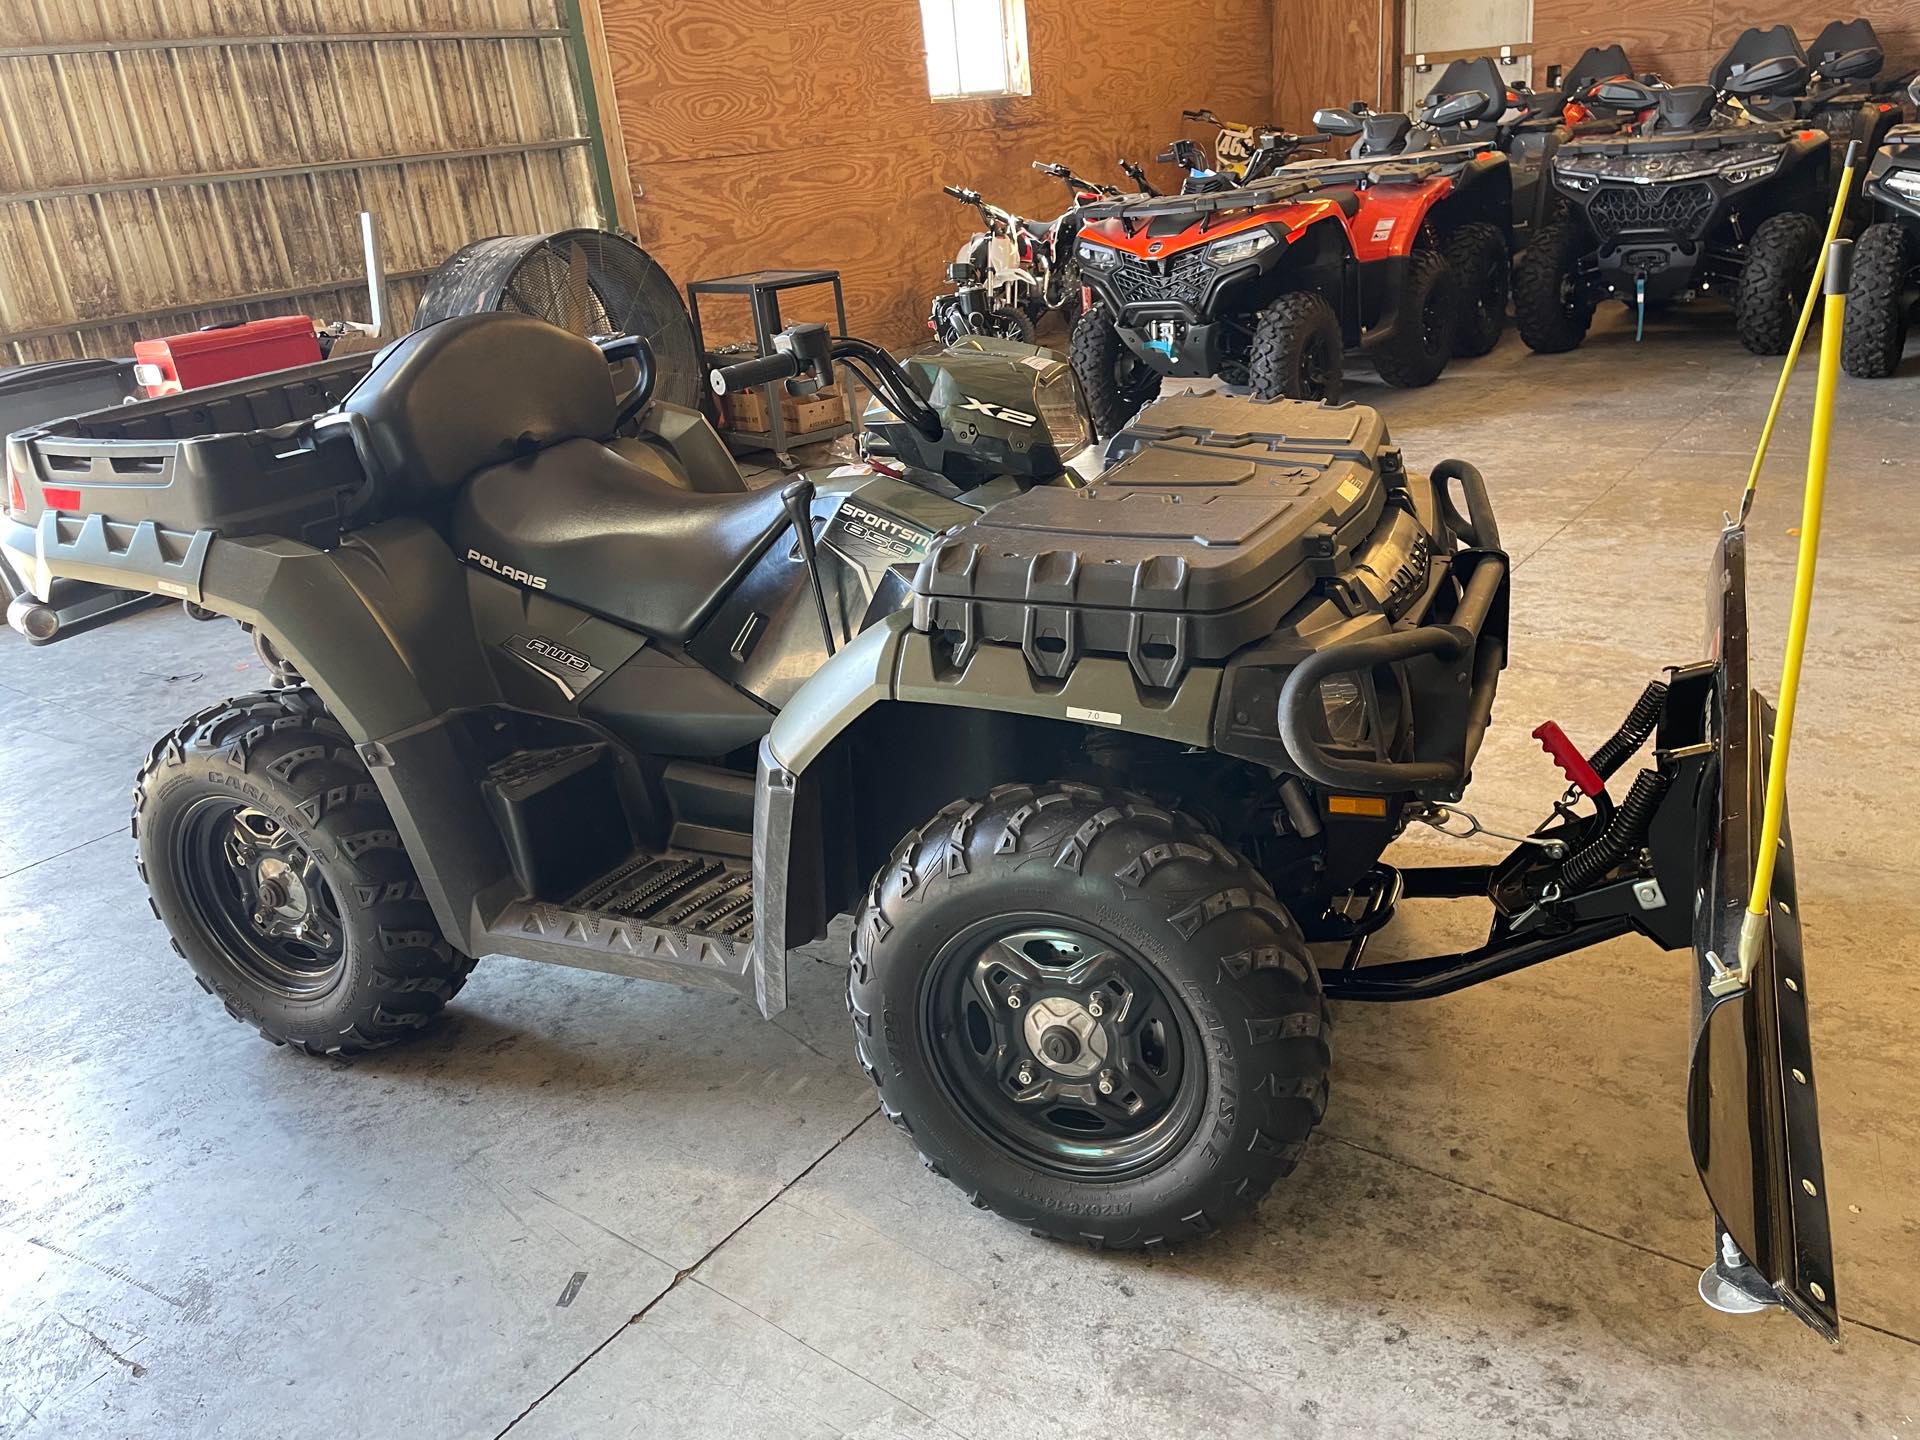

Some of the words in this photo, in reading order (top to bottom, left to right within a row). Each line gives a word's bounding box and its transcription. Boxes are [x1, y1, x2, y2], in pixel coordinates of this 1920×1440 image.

[957, 394, 1038, 429] X2
[843, 521, 914, 557] 850
[467, 549, 548, 590] POLARIS
[526, 639, 591, 672] AWD
[208, 771, 331, 866] CARLISLE
[1182, 980, 1237, 1169] CARLISLE
